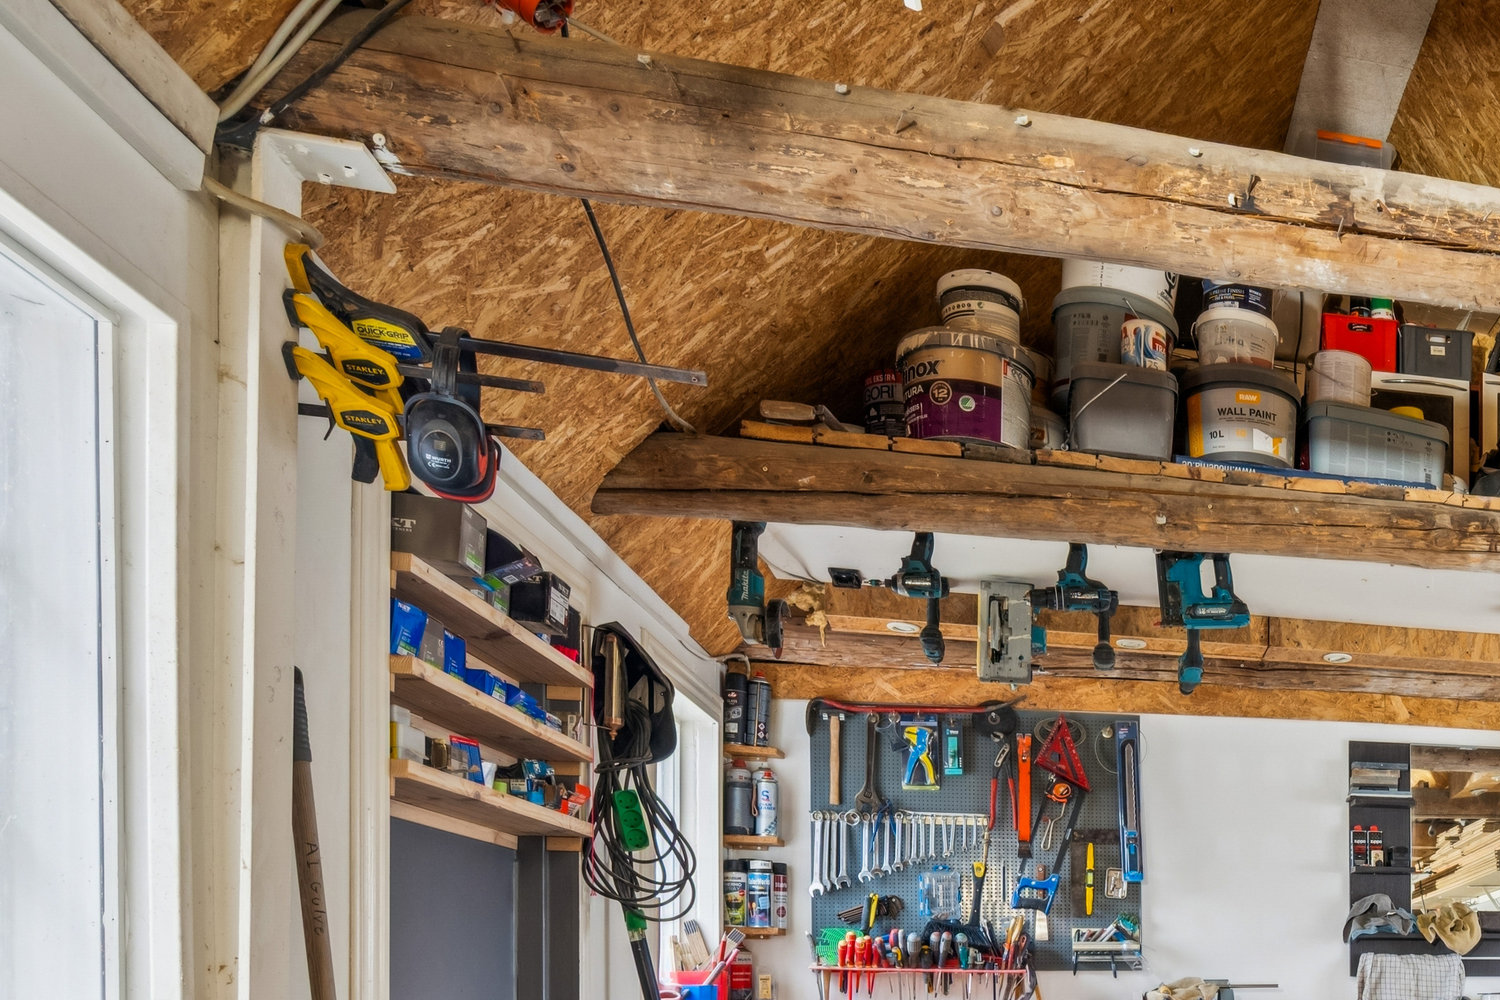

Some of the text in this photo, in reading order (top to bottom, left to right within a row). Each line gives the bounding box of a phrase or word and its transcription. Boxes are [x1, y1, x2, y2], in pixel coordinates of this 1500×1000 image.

[356, 325, 410, 340] QUICK-GRIP
[345, 363, 385, 376] STANLEY
[932, 387, 949, 399] 12
[1238, 393, 1258, 402] RAW
[344, 414, 383, 426] STANLEY
[1217, 406, 1247, 417] WALL
[1249, 407, 1278, 422] PAINT
